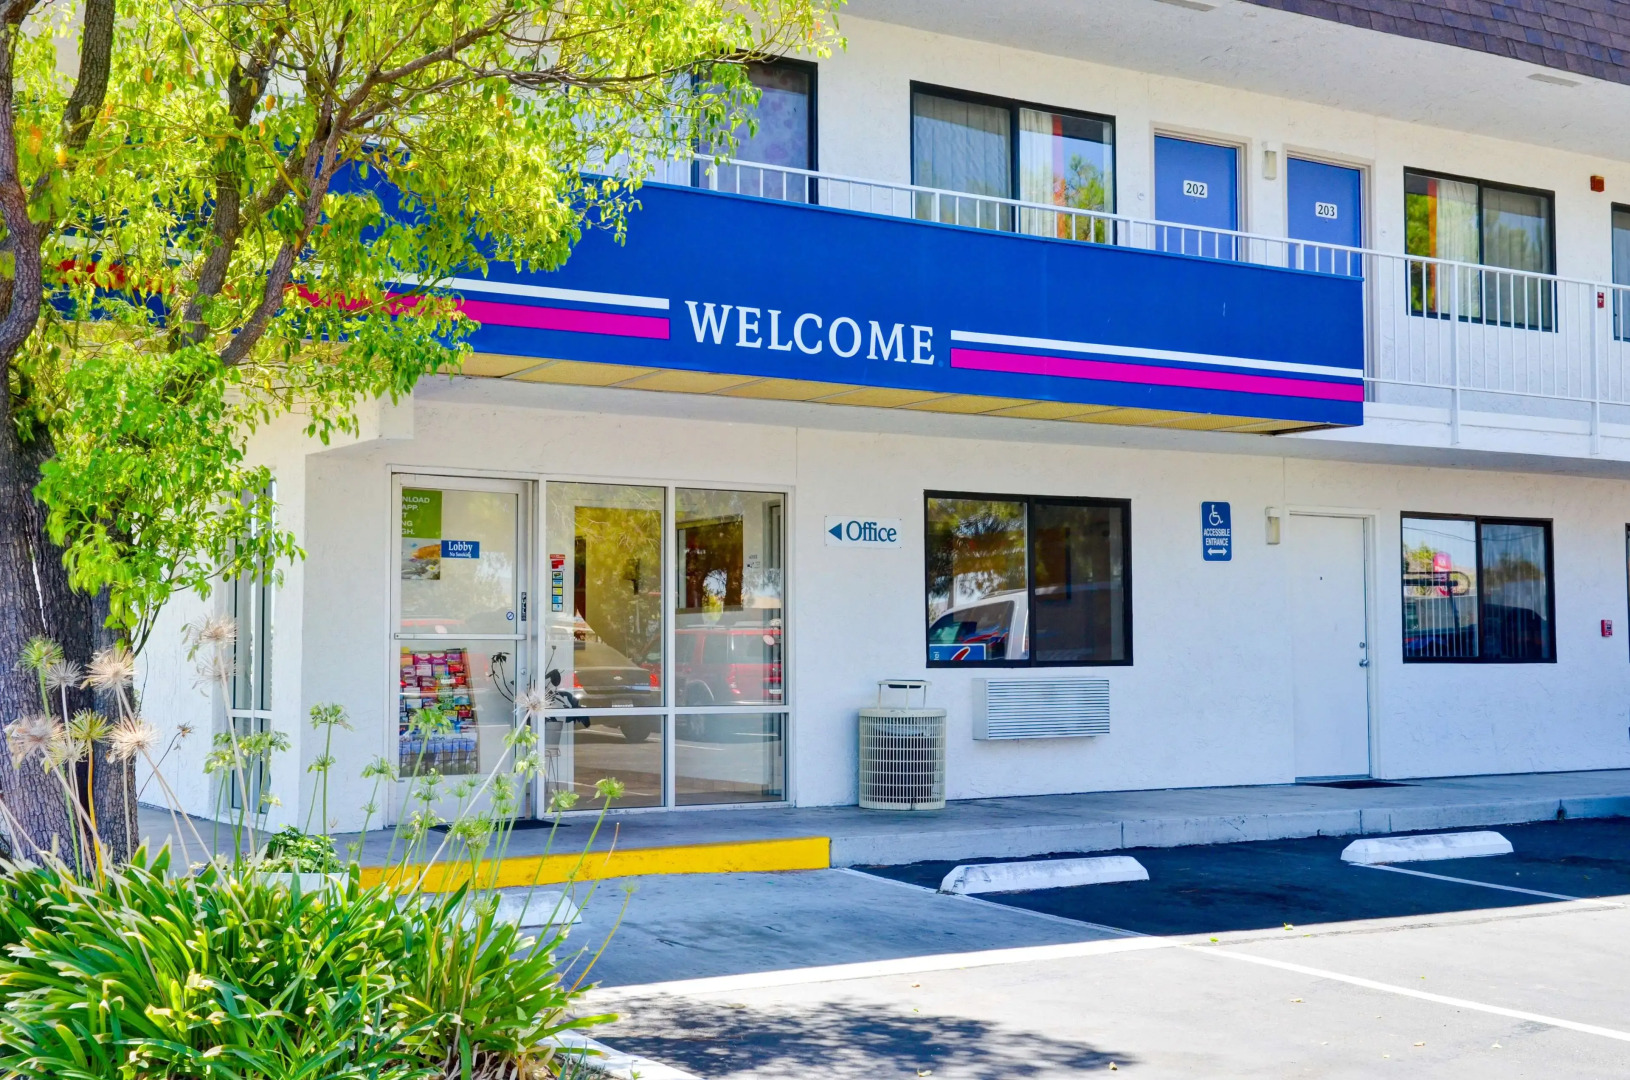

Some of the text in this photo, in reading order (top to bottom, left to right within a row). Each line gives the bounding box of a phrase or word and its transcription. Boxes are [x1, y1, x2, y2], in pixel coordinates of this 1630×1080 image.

[1186, 182, 1205, 196] 202
[1318, 204, 1335, 217] 203
[685, 300, 935, 365] WELCOME
[846, 520, 897, 542] Office
[1203, 528, 1231, 537] ACCESSIBLE
[448, 541, 473, 552] Lobby
[1205, 537, 1229, 546] ENTRANCE
